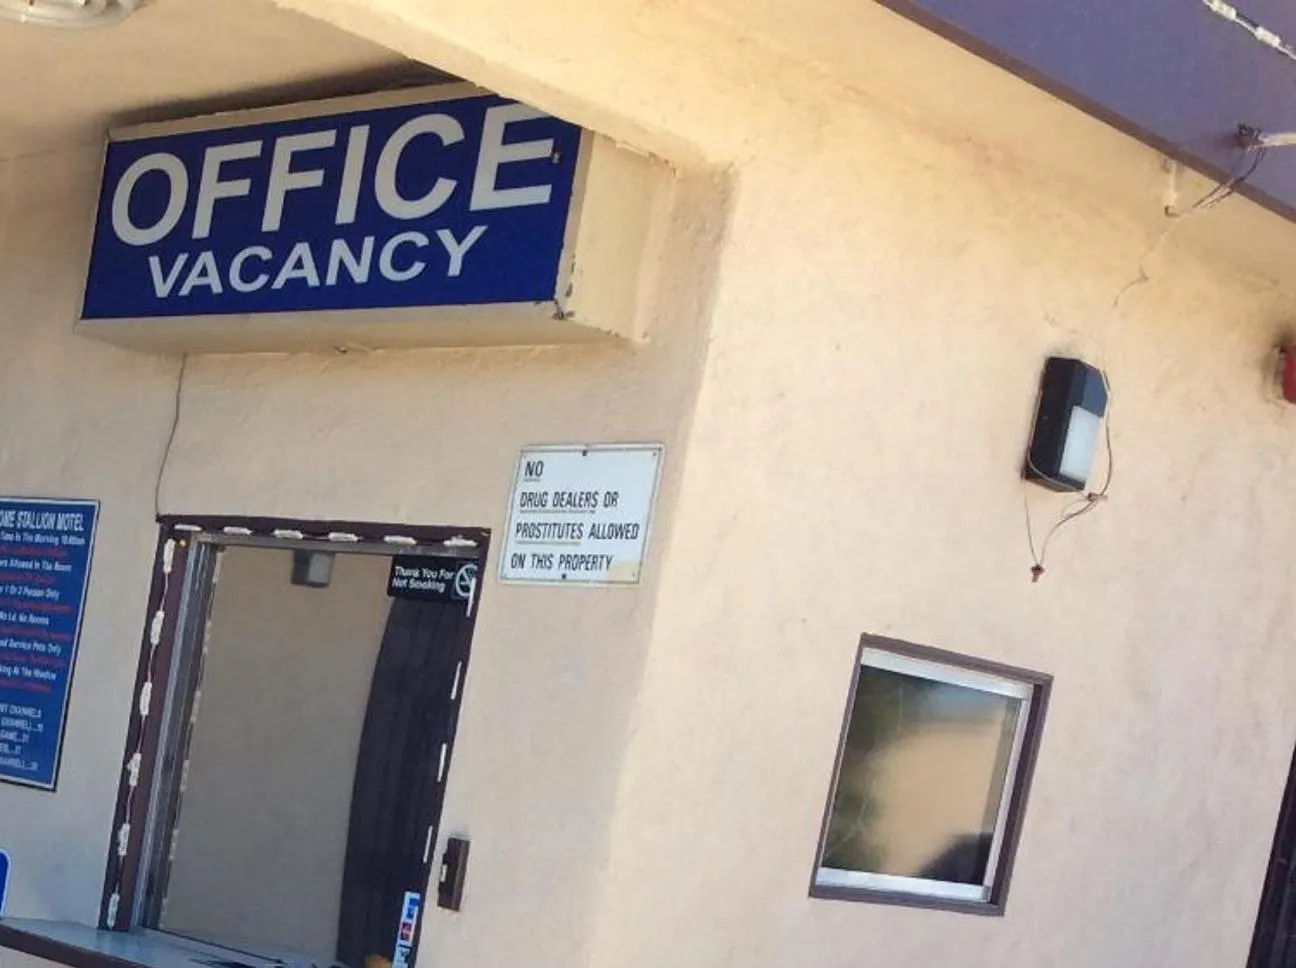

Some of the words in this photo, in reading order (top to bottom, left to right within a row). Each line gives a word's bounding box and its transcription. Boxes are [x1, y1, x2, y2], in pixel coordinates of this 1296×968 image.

[111, 101, 555, 246] OFFICE
[147, 224, 488, 299] VACANCY
[524, 460, 544, 477] NO
[519, 491, 548, 508] DRUG
[552, 491, 598, 508] DEALERS
[603, 491, 619, 508] OR
[16, 511, 55, 529] STALLION
[56, 513, 84, 531] MOTEL
[515, 522, 584, 540] PROSTITUTES
[588, 523, 640, 540] ALLOWED
[510, 552, 526, 569] ON
[531, 552, 554, 570] THIS
[557, 554, 614, 571] PROPERTY
[395, 565, 420, 577] Thank
[422, 567, 437, 578] You
[438, 569, 455, 580] For
[392, 577, 408, 588] Not
[408, 578, 446, 593] Smoking
